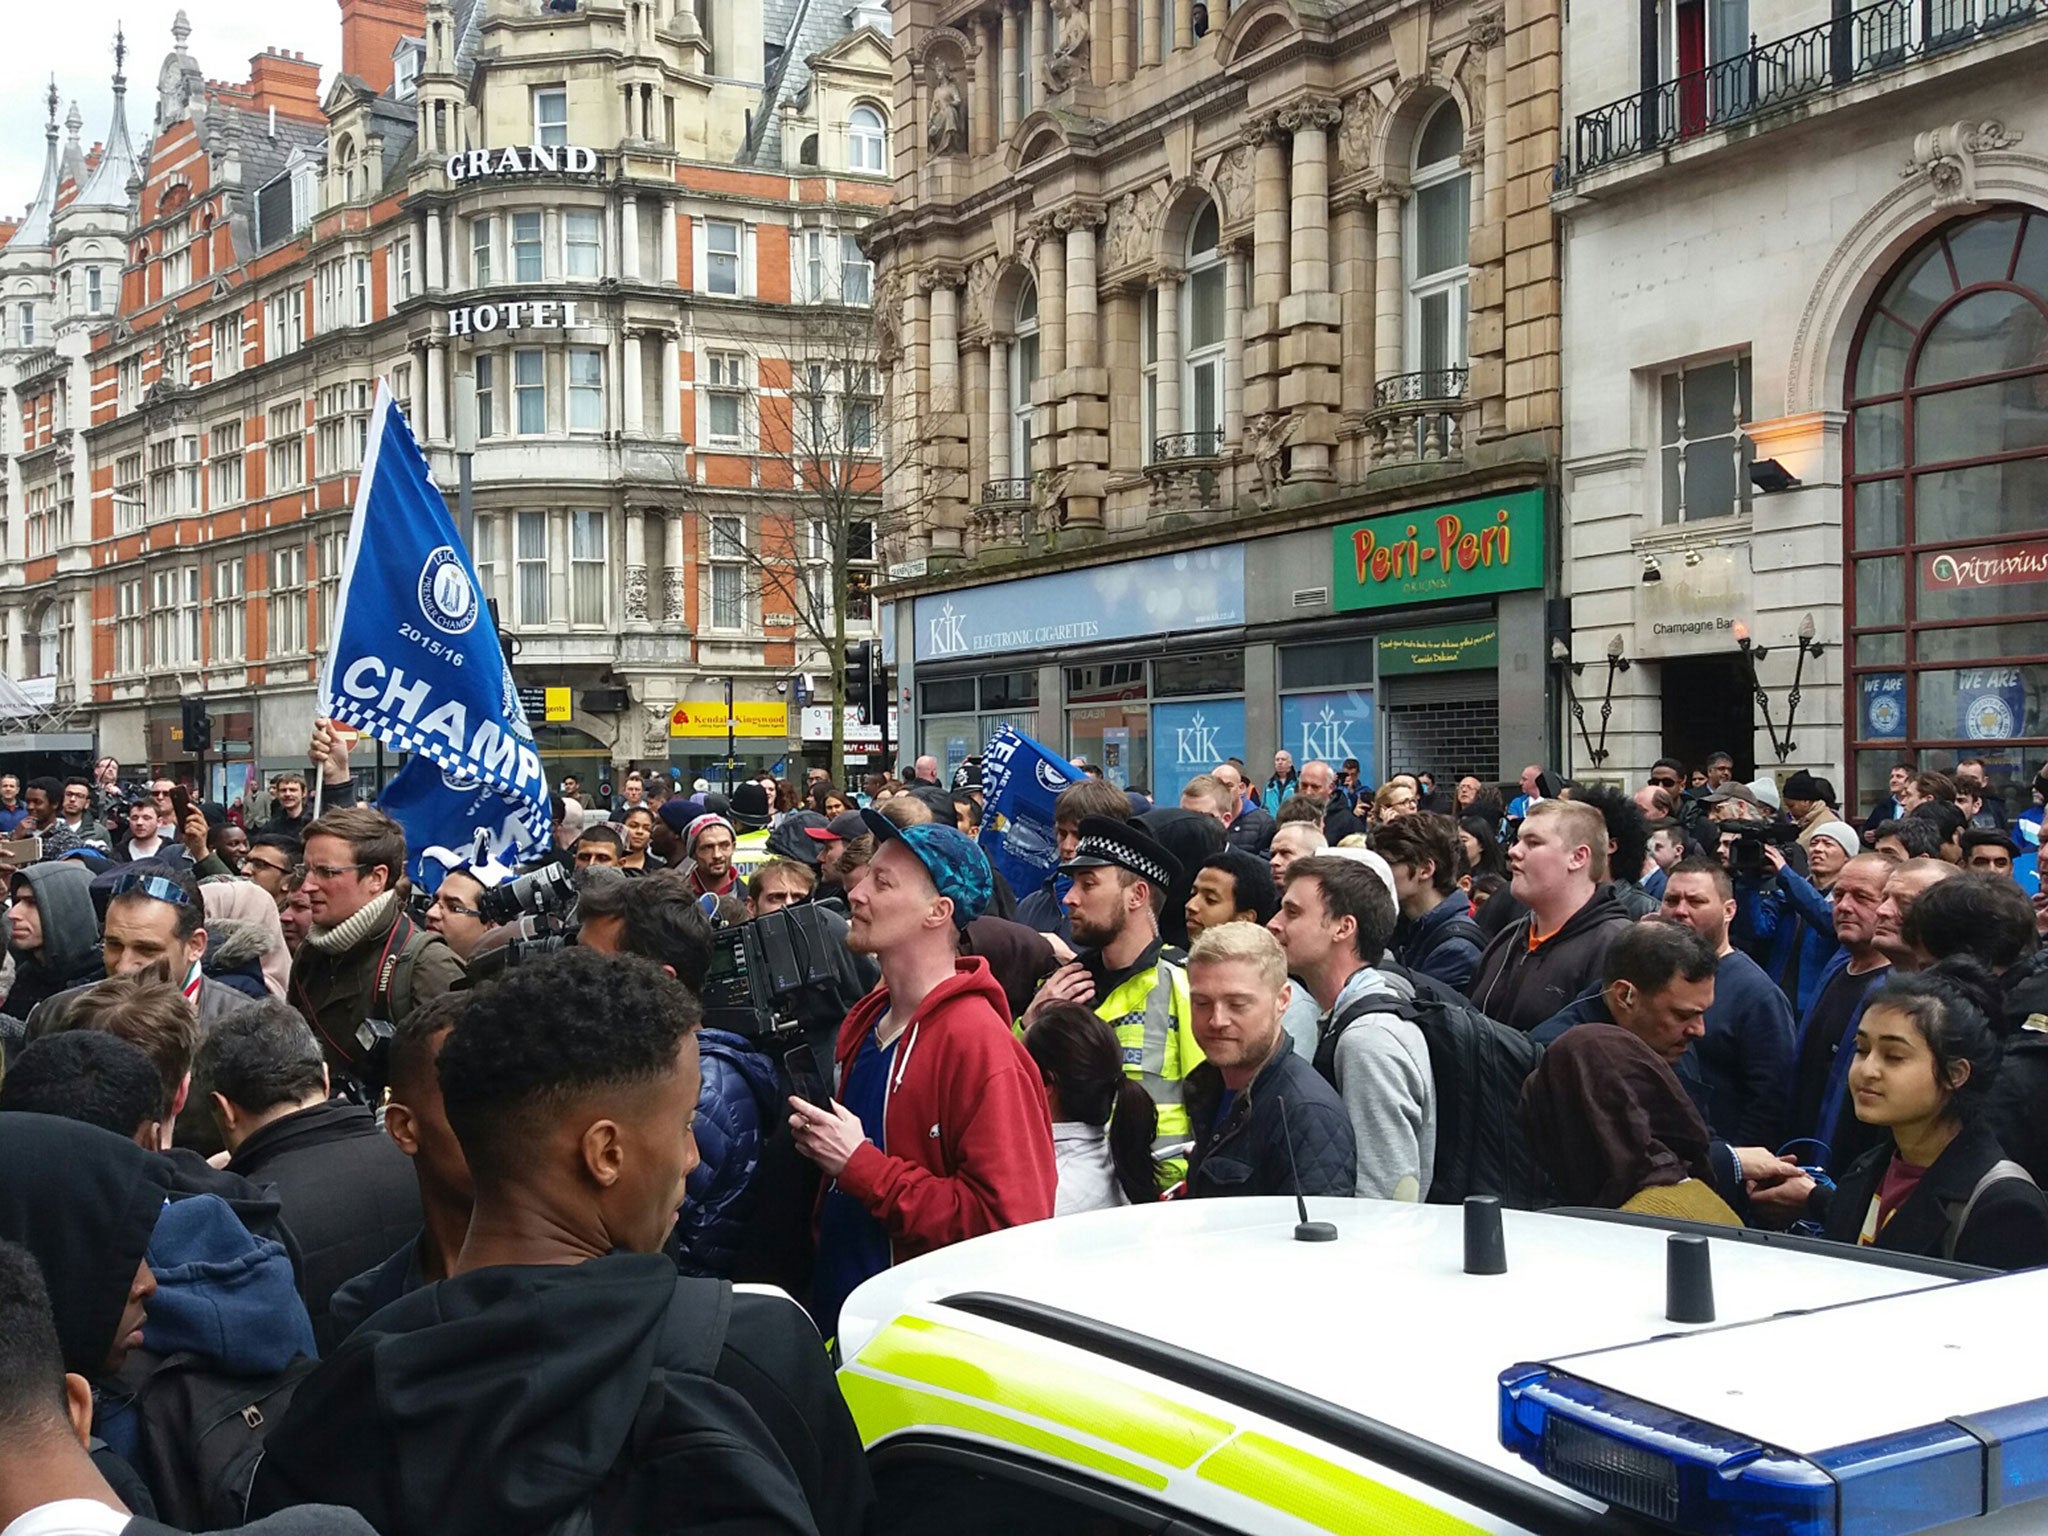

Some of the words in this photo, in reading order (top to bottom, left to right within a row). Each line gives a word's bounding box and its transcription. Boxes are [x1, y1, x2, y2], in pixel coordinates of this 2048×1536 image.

[446, 144, 597, 181] GRAND
[447, 301, 590, 337] HOTEL
[1351, 509, 1510, 585] Peri-Peri
[1933, 550, 2048, 585] Vitruvius
[421, 576, 439, 619] PREMIER
[929, 610, 969, 655] KIK
[972, 628, 1033, 650] ELECTRONIC
[1035, 620, 1099, 643] CIGARETTES
[1653, 620, 1713, 634] Champagne
[1716, 617, 1735, 629] Bar
[398, 622, 464, 667] 2015/16
[1864, 679, 1880, 692] WE
[1882, 678, 1903, 691] ARE
[1958, 671, 1981, 690] WE
[1986, 668, 2020, 688] ARE
[736, 715, 785, 725] Kingswood
[1301, 715, 1358, 761] KIK
[1176, 722, 1223, 764] KIK
[999, 768, 1012, 788] WE
[378, 954, 397, 992] Canon
[1123, 1049, 1142, 1063] ICE
